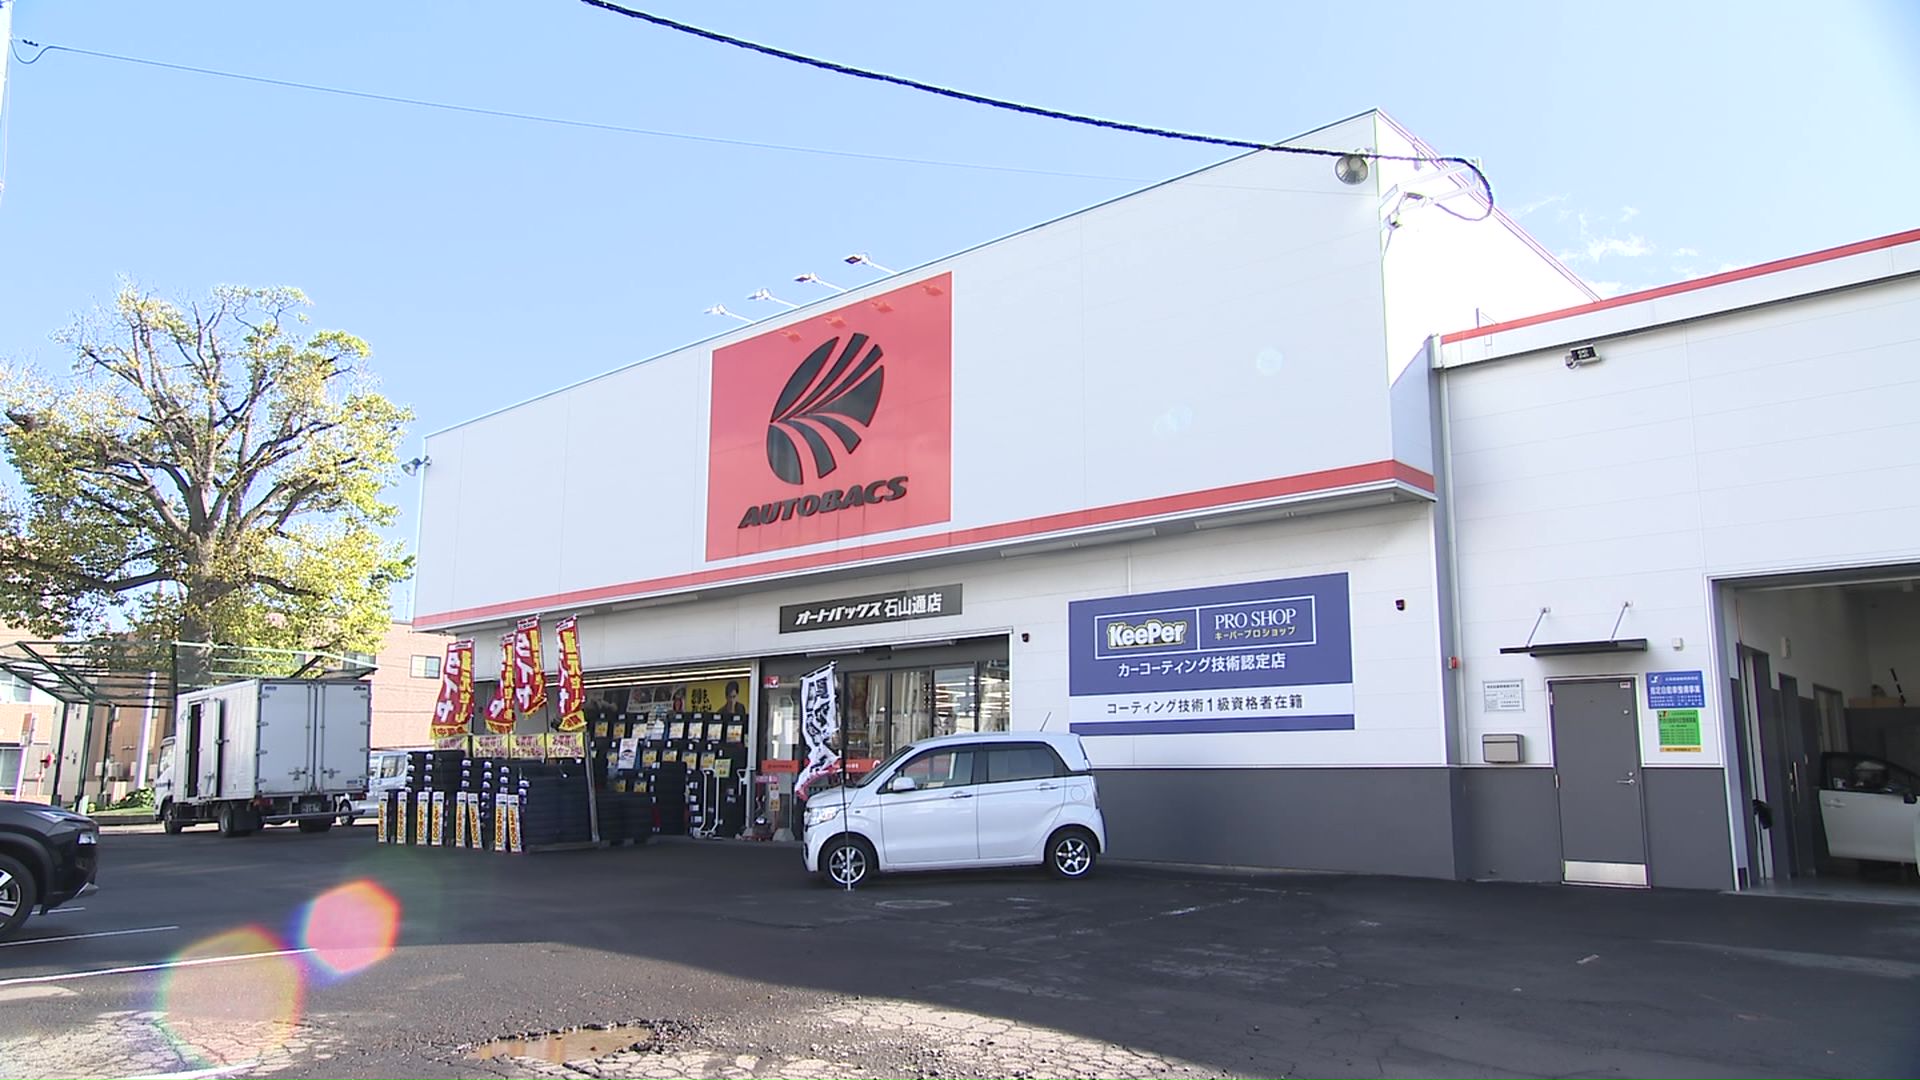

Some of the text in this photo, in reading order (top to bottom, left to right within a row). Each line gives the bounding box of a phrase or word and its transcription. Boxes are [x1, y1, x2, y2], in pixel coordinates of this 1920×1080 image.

[738, 476, 909, 529] AUTOBACS
[1215, 608, 1296, 630] PRO SHOP
[1107, 619, 1187, 649] KeePer
[1215, 626, 1296, 641] キーパープロショップ
[1117, 652, 1287, 678] カーコーティング技術認定店
